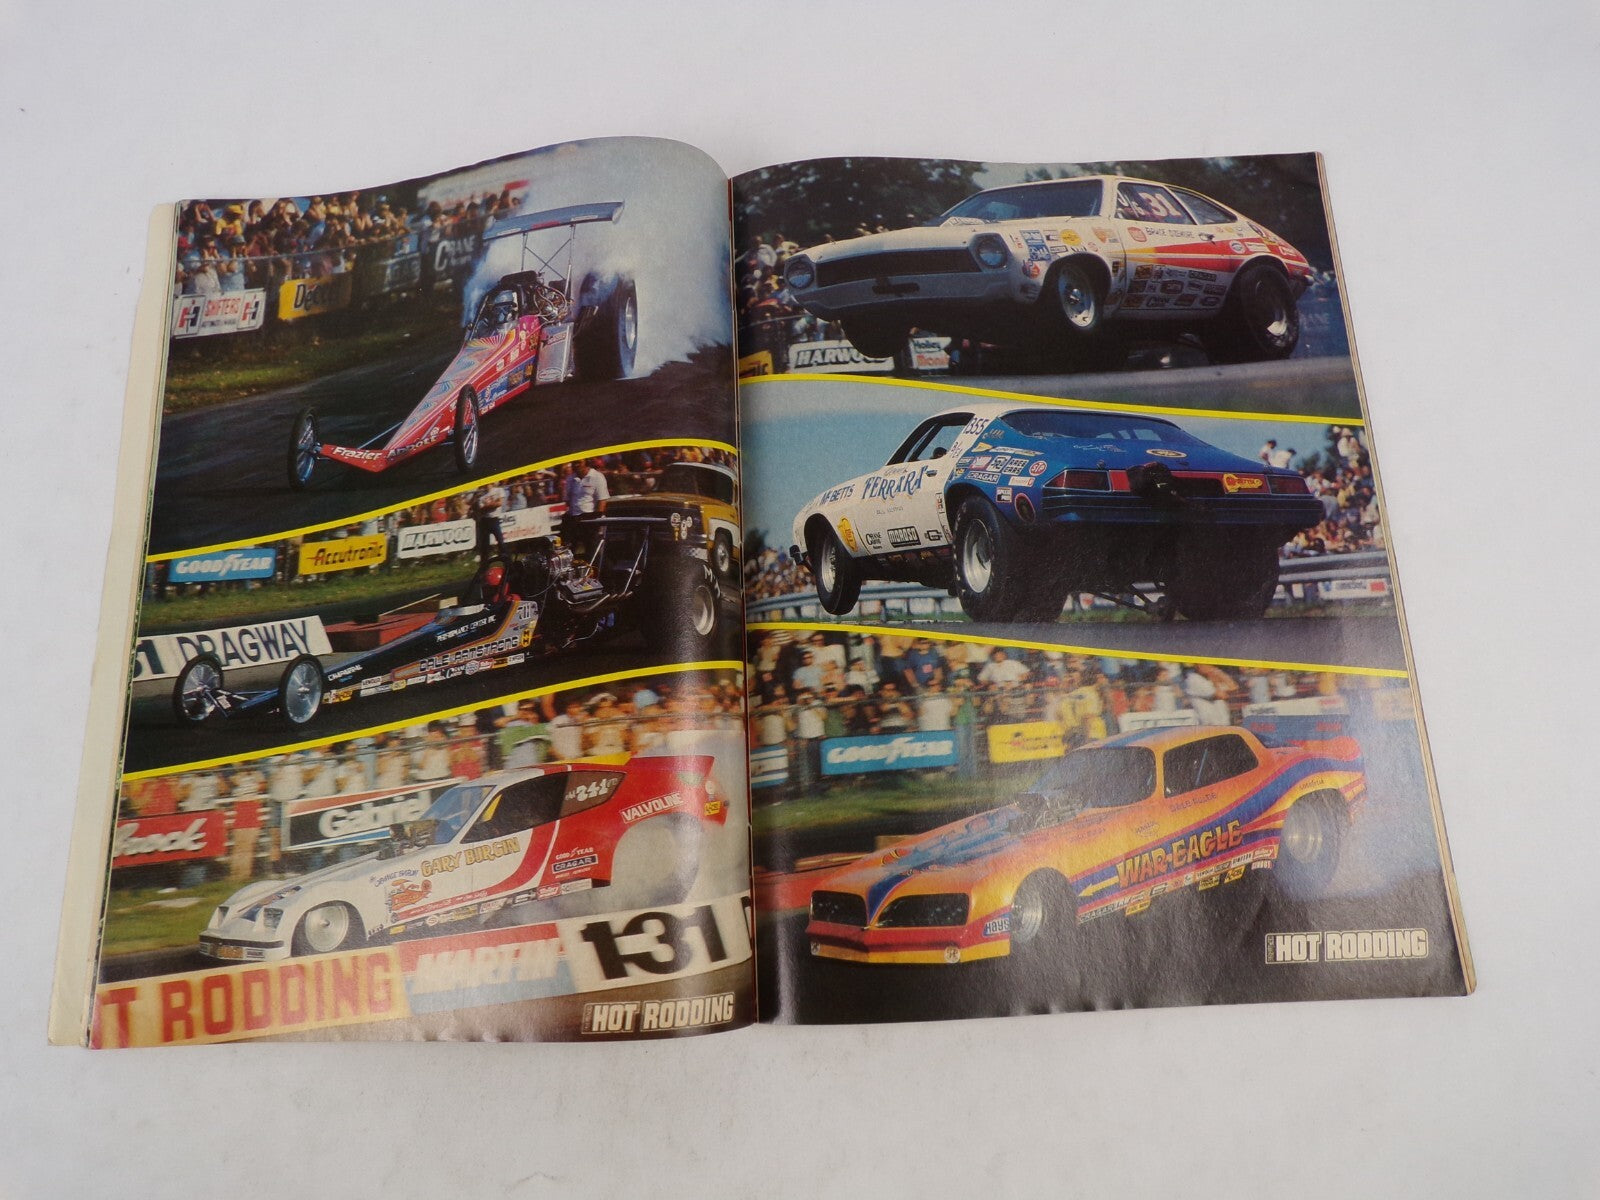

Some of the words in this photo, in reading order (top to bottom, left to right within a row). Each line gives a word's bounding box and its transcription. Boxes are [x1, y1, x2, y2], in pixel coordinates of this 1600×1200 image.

[333, 446, 382, 461] Frazier
[967, 472, 999, 482] CRAGAR
[176, 553, 272, 577] GOODYEAR
[176, 619, 311, 668] DRAGWAY
[575, 778, 609, 802] 241
[621, 794, 683, 822] VALVOLINE
[420, 852, 462, 877] GARY
[464, 837, 520, 866] BURGIN
[555, 847, 594, 859] GOODYEAR
[555, 858, 593, 871] CRAGAR
[1116, 819, 1244, 888] WAR-EAGLE
[985, 919, 1010, 934] Hays
[1276, 933, 1320, 961] HOT
[1326, 929, 1427, 960] RODDING
[160, 951, 392, 1043] RODDING
[592, 1003, 638, 1032] HOT
[643, 994, 735, 1031] RODDING
